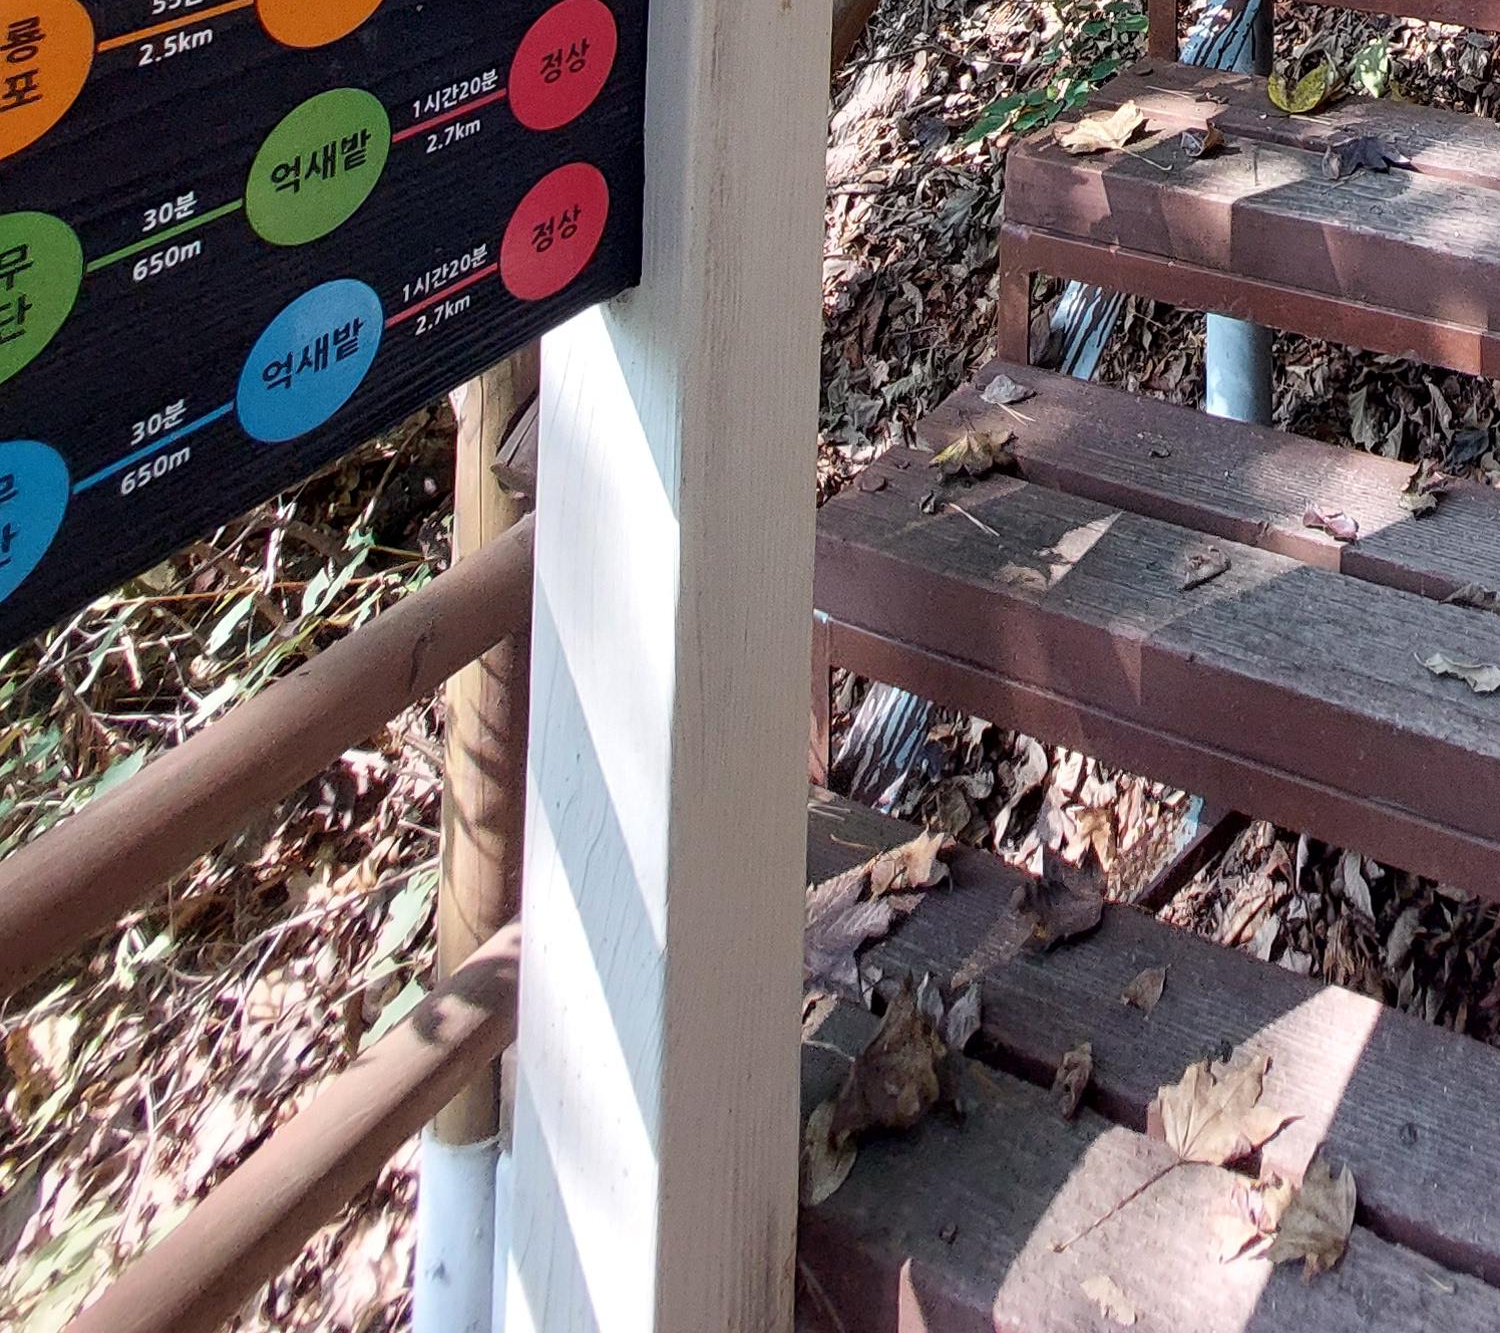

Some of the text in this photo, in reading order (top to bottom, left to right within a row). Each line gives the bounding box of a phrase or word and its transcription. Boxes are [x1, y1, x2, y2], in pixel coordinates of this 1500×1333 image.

[138, 28, 213, 67] 2.5km
[540, 38, 590, 84] 정상
[412, 68, 498, 118] 1시간20분
[426, 117, 481, 154] 2.7km
[269, 128, 372, 194] 억새밭
[142, 191, 198, 232] 30분
[530, 204, 582, 253] 정상
[132, 238, 201, 282] 650m
[402, 243, 488, 303] 1시간20분
[414, 293, 470, 336] 2.7km
[261, 317, 365, 390] 억새밭
[130, 398, 188, 446] 30분
[120, 446, 191, 496] 650m
